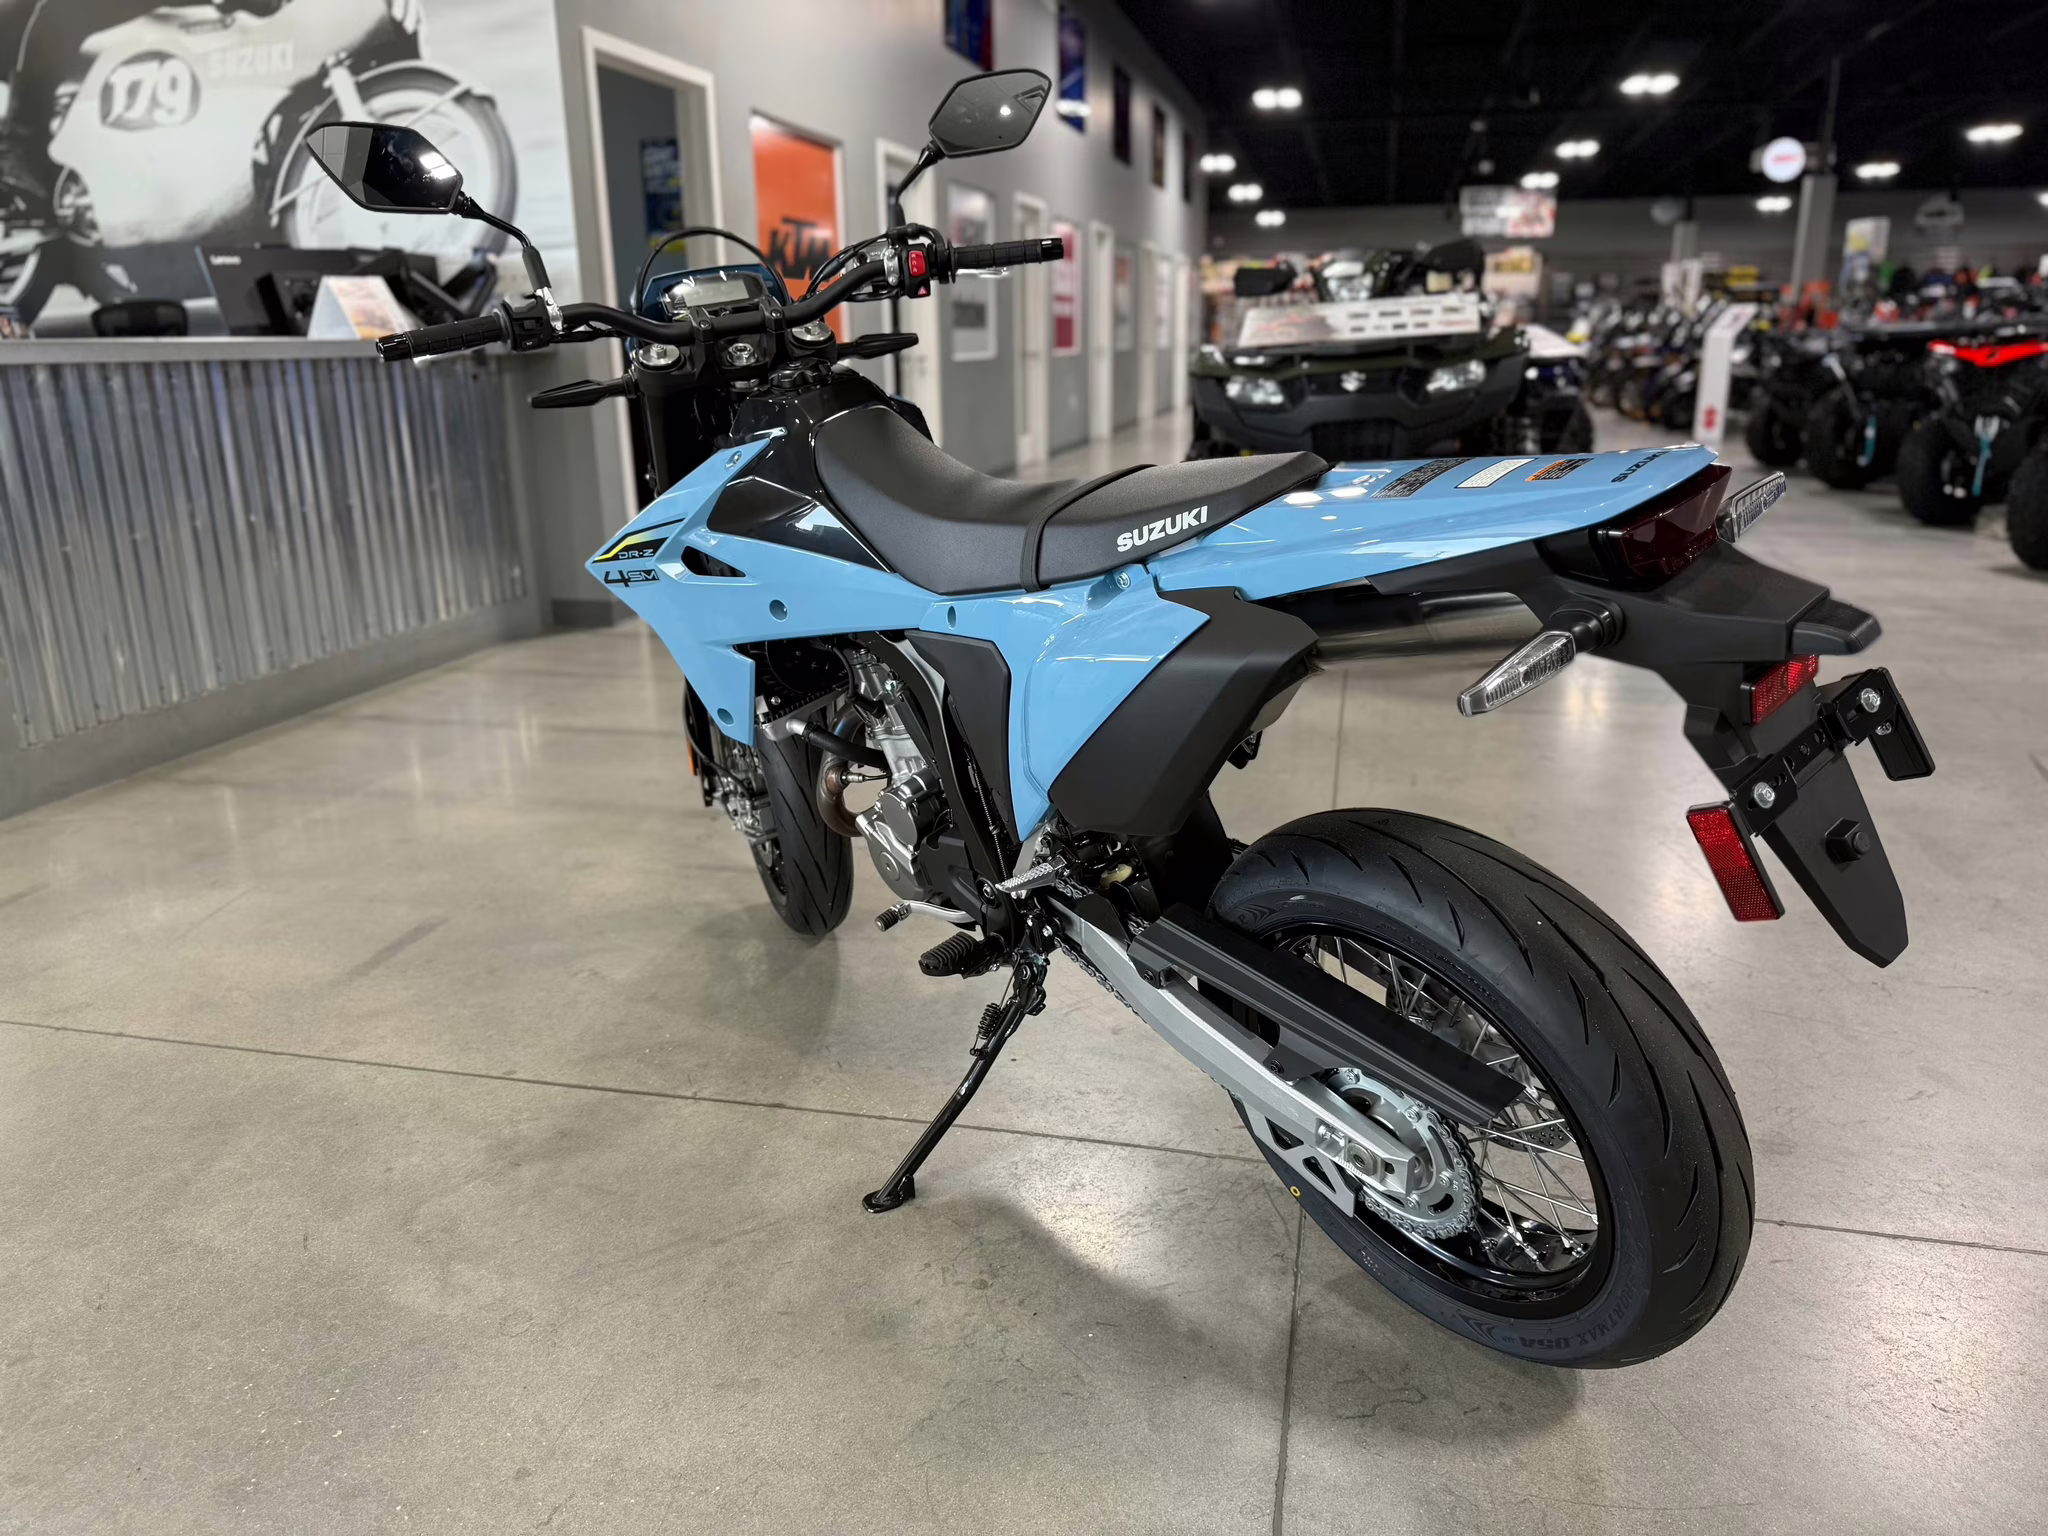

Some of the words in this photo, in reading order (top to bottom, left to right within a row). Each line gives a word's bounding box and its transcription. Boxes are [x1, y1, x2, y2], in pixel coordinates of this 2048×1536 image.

[207, 43, 294, 79] SUZUKI
[106, 57, 192, 124] 179
[768, 215, 831, 280] KTM
[1116, 505, 1208, 552] SUZUKI
[618, 548, 654, 559] DR-Z
